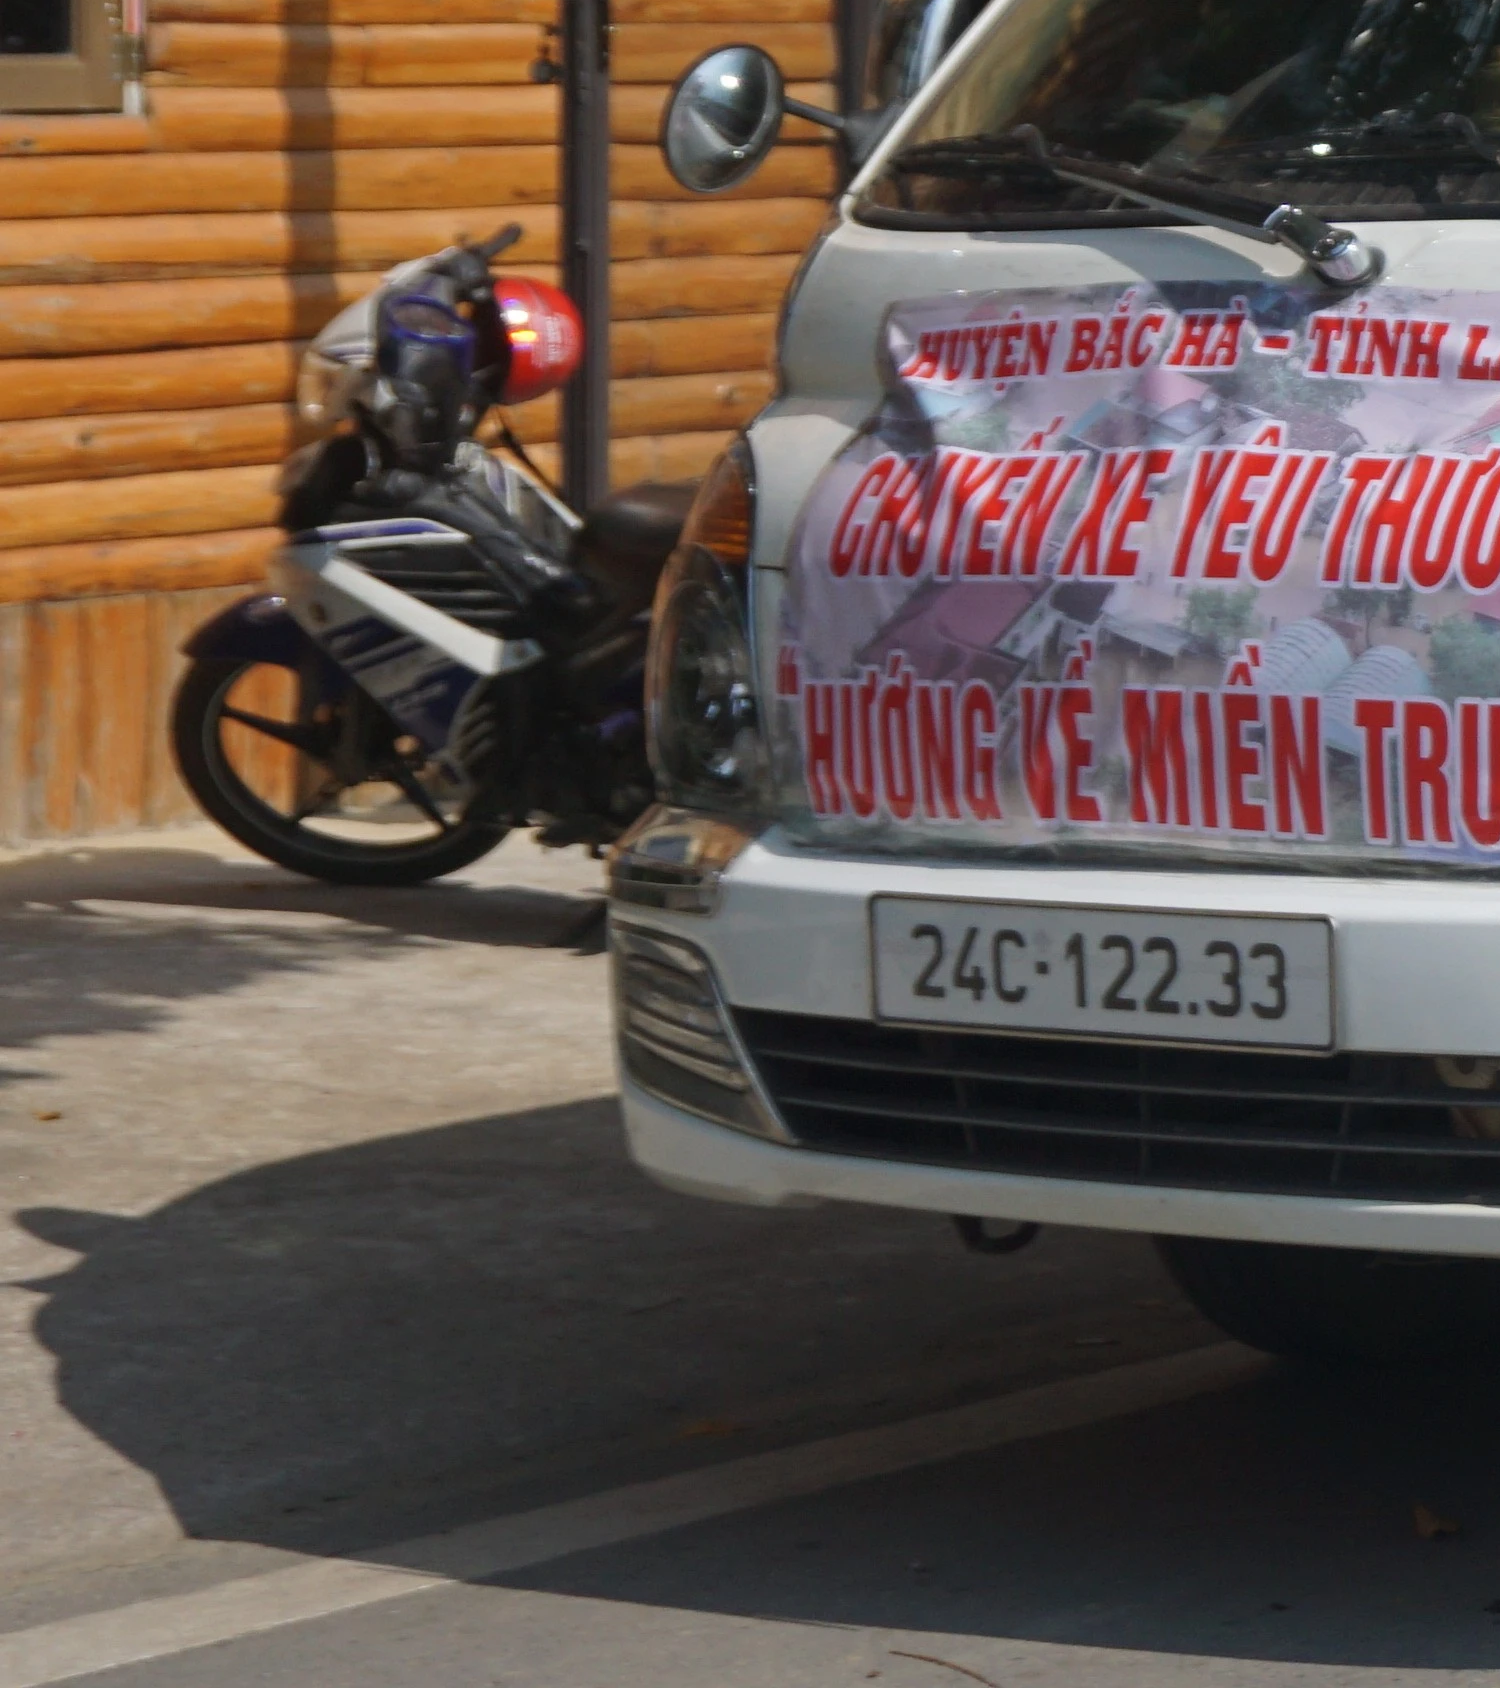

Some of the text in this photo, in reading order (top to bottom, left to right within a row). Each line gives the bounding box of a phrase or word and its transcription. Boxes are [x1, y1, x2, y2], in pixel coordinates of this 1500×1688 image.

[900, 310, 1056, 392] HUYỆN
[1063, 290, 1166, 374] BẮC
[1166, 299, 1245, 367] HÀ
[1308, 302, 1448, 379] TỈNH
[829, 416, 1085, 578] CHUYẾN
[1057, 448, 1175, 577] XE
[1171, 424, 1330, 582] YÊU
[1020, 639, 1101, 822] VỀ
[1123, 647, 1324, 838] MIỀN
